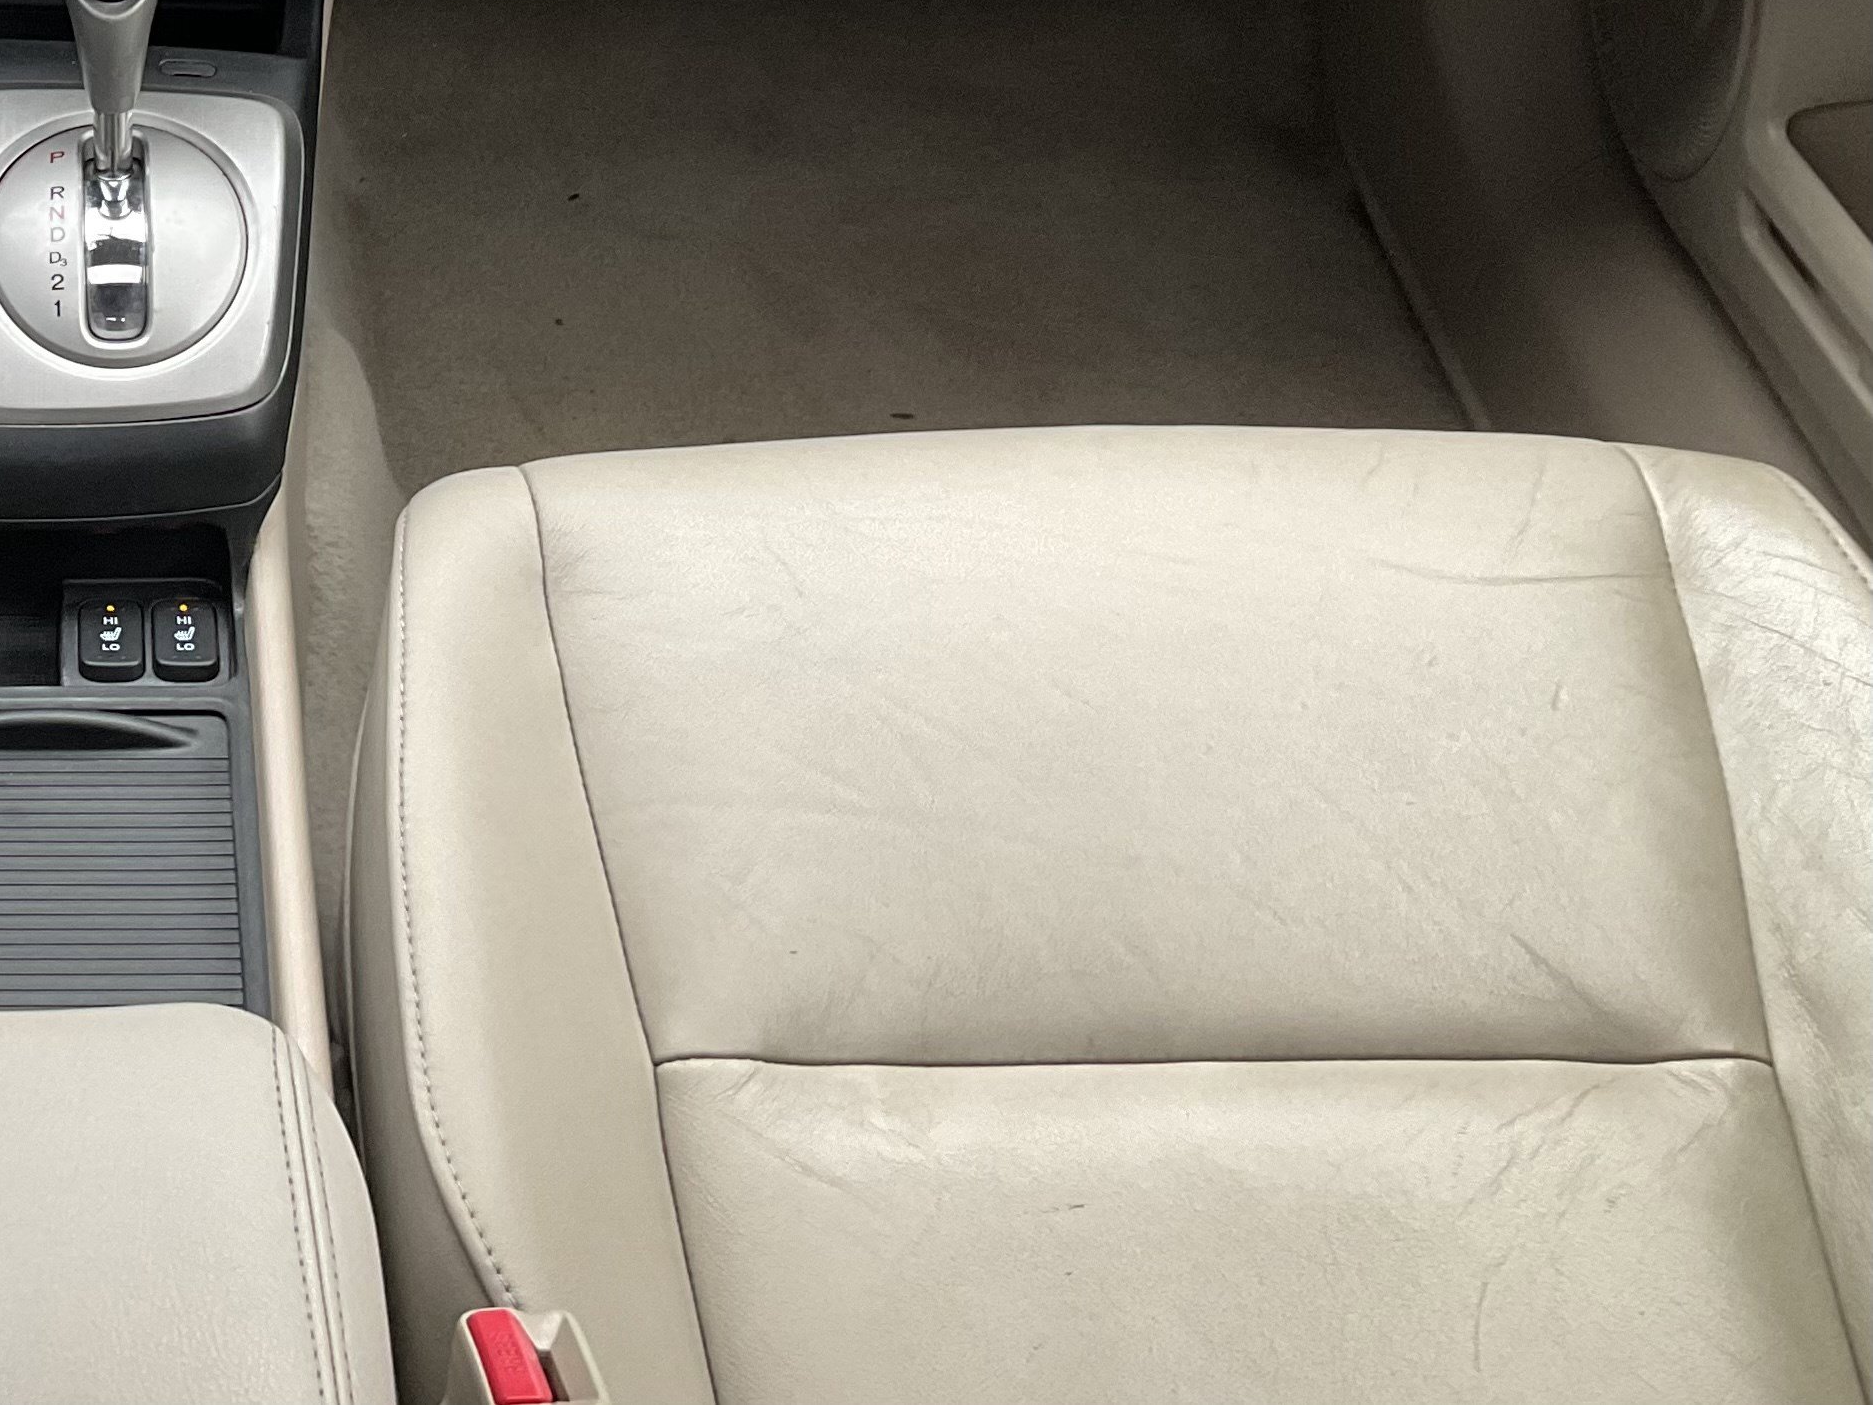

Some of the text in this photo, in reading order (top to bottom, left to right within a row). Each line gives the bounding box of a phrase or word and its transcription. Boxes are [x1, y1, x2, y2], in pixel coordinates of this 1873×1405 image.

[49, 151, 65, 163] P
[50, 186, 65, 200] R
[49, 206, 65, 221] N
[50, 226, 66, 243] D
[51, 274, 65, 291] 2
[53, 299, 62, 317] 1
[102, 616, 119, 625] HI
[176, 616, 192, 625] HI
[101, 643, 121, 651] LO
[176, 643, 195, 651] LO
